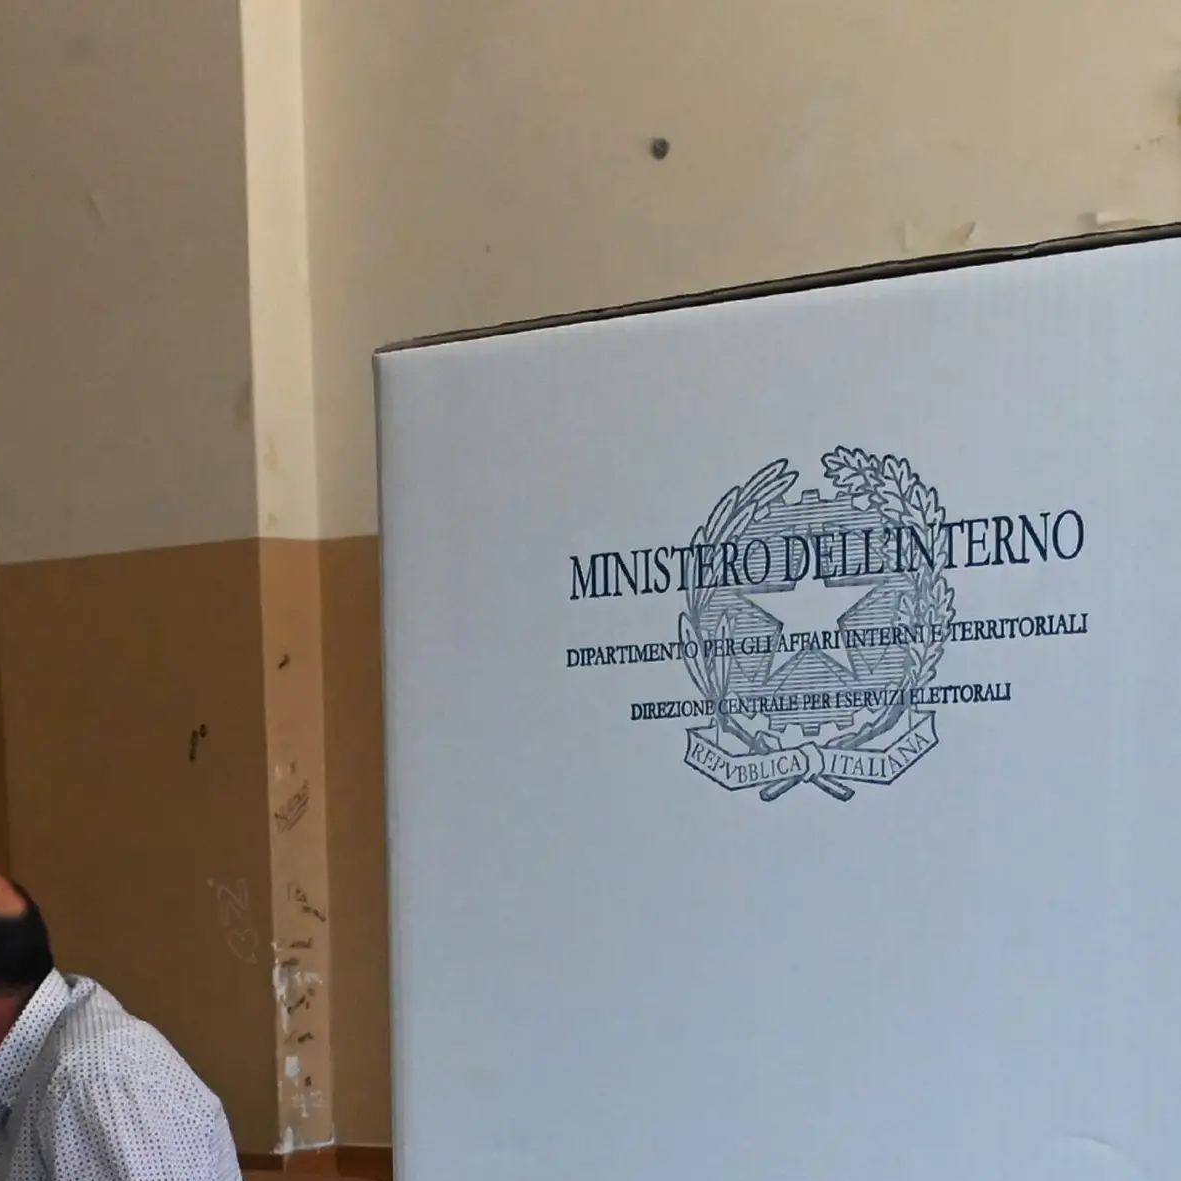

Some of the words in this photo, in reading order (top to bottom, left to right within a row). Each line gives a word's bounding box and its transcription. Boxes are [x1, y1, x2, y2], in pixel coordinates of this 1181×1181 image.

[569, 539, 771, 600] MINISTERO
[782, 508, 1085, 583] DELL'INTERNO
[566, 640, 699, 668] DIPARTIMENTO
[704, 638, 736, 658] PER
[741, 635, 773, 655] GLI
[777, 629, 841, 654] AFFARI
[845, 626, 925, 649] INTERNI
[930, 624, 946, 644] E
[950, 612, 1089, 642] TERRITORIALI
[630, 700, 716, 721] DIREZIONE
[718, 694, 798, 716] CENTRALE
[802, 692, 832, 711] PER
[843, 688, 906, 709] SERVIZI
[909, 682, 1012, 706] ELETTORALI
[691, 742, 803, 785] REPVBBLICA
[830, 731, 931, 778] ITALIANA
